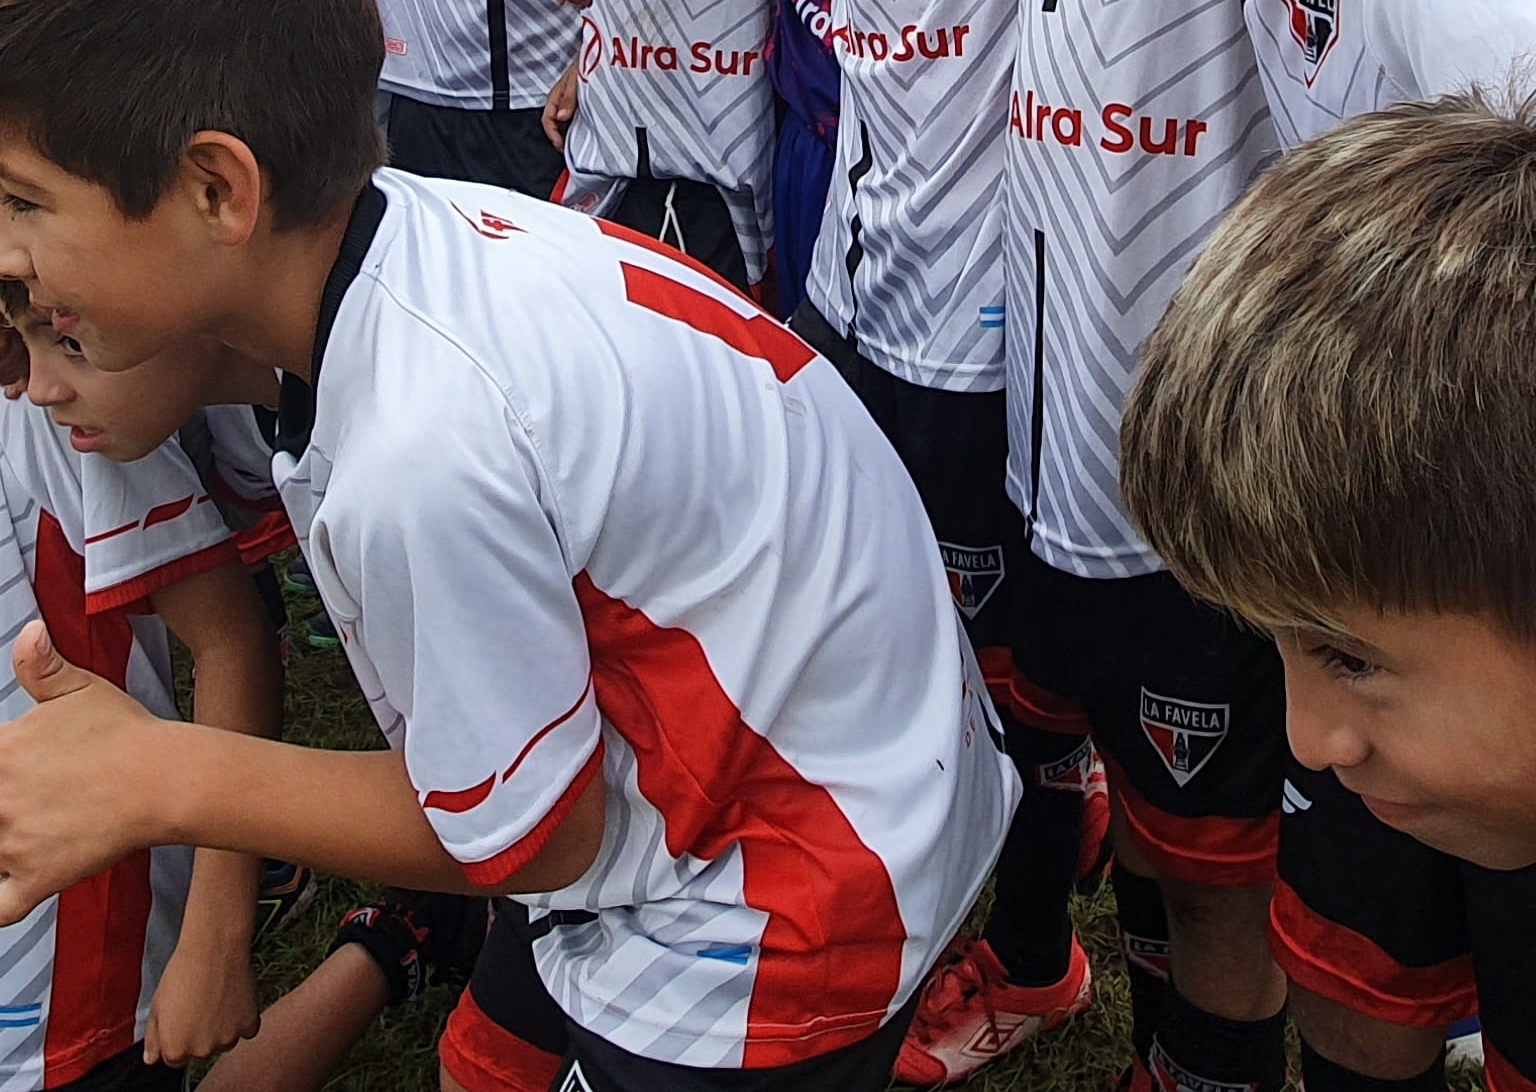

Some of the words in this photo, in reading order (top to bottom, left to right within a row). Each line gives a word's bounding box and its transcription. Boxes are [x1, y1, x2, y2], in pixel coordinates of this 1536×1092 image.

[610, 36, 678, 71] Alra
[689, 41, 759, 76] Sur
[892, 25, 970, 62] Sur
[1009, 90, 1082, 147] Alra
[1100, 103, 1207, 157] Sur
[952, 550, 996, 569] FAVELA
[1144, 697, 1160, 719] LA
[1165, 704, 1221, 729] FAVELA
